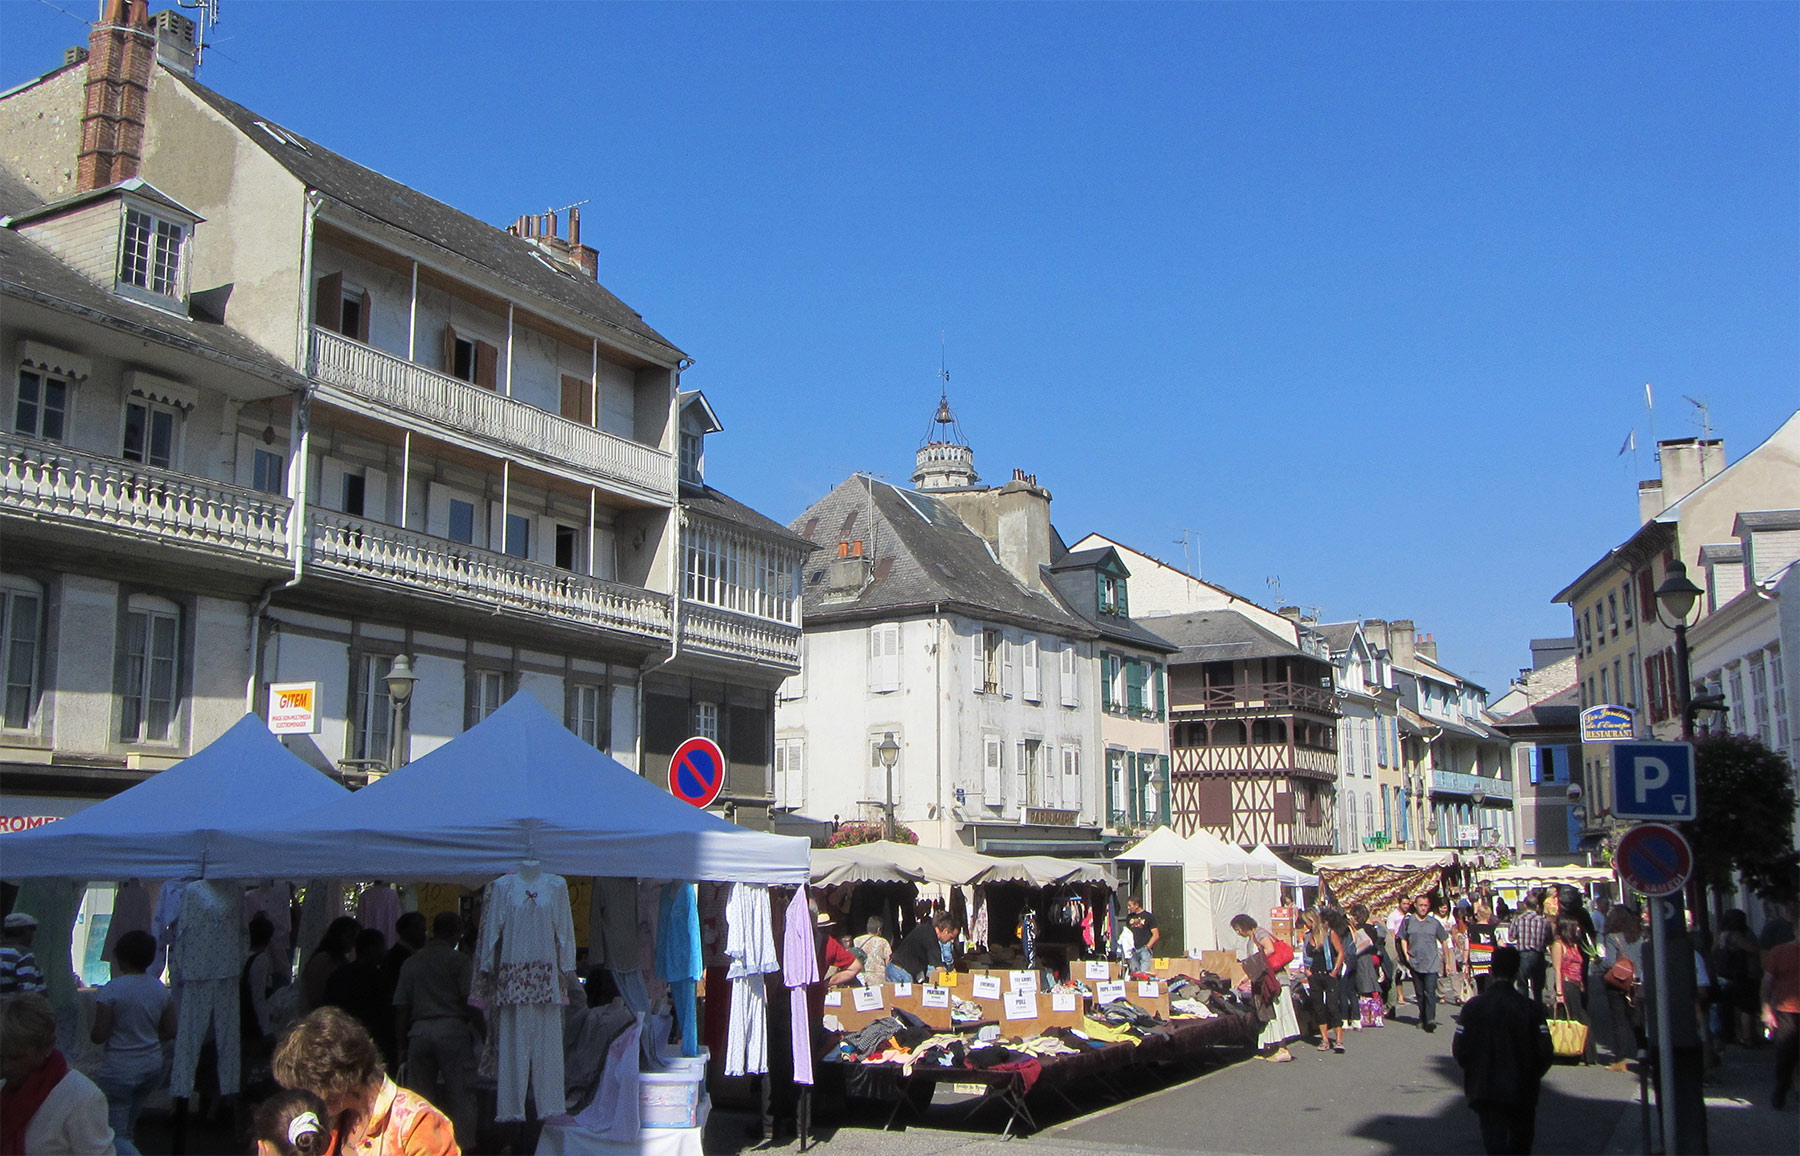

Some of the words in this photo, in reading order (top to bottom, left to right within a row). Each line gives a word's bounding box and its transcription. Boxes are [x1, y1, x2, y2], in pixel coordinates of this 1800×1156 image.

[279, 693, 308, 709] GITEM
[1586, 729, 1633, 738] RESTAURANT
[1634, 756, 1670, 803] P
[1643, 873, 1686, 892] SAMEDI
